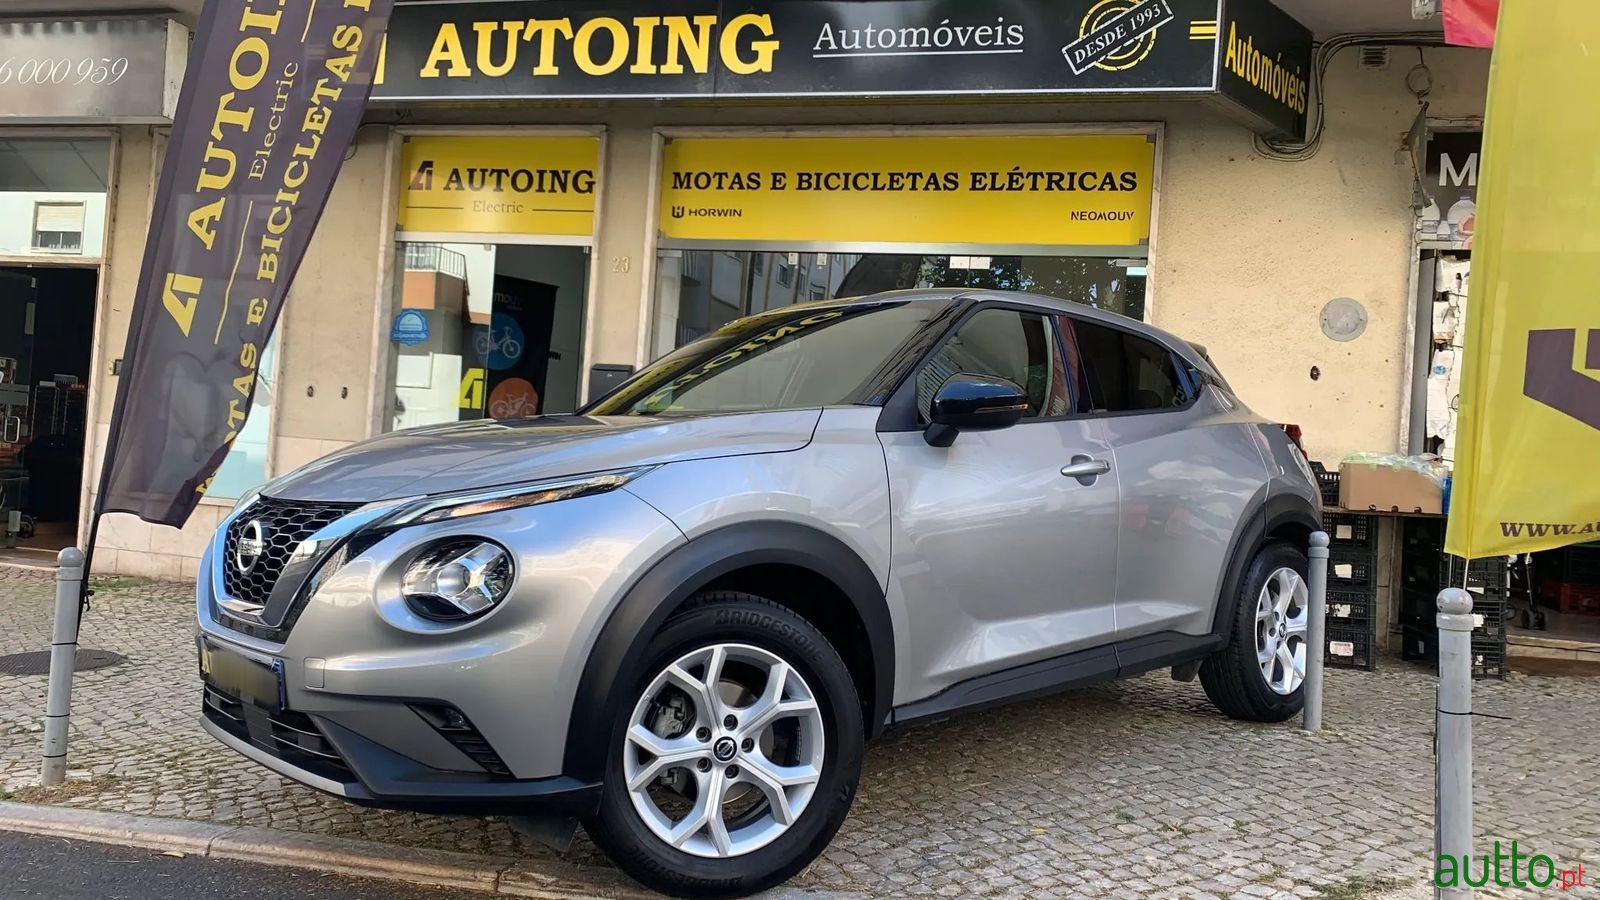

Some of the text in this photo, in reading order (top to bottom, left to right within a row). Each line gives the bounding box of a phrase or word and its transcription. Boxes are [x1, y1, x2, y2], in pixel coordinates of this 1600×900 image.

[420, 14, 780, 78] AUTOING
[813, 17, 1024, 51] Automóveis
[1074, 4, 1162, 64] DESDE 1993
[18, 57, 71, 85] 000
[73, 57, 129, 86] 959
[1225, 21, 1307, 115] Automóveis
[187, 0, 286, 250] AUTOI
[248, 61, 299, 182] Electric
[256, 25, 363, 283] BICICLETAS
[443, 168, 597, 194] AUTOING
[672, 166, 1138, 193] MOTAS E BICICLETAS ELÉTRICAS
[472, 200, 524, 213] Electric
[688, 208, 743, 217] HORWIN
[1071, 211, 1135, 221] NEOMOUV
[612, 256, 631, 273] 23
[246, 297, 269, 327] E
